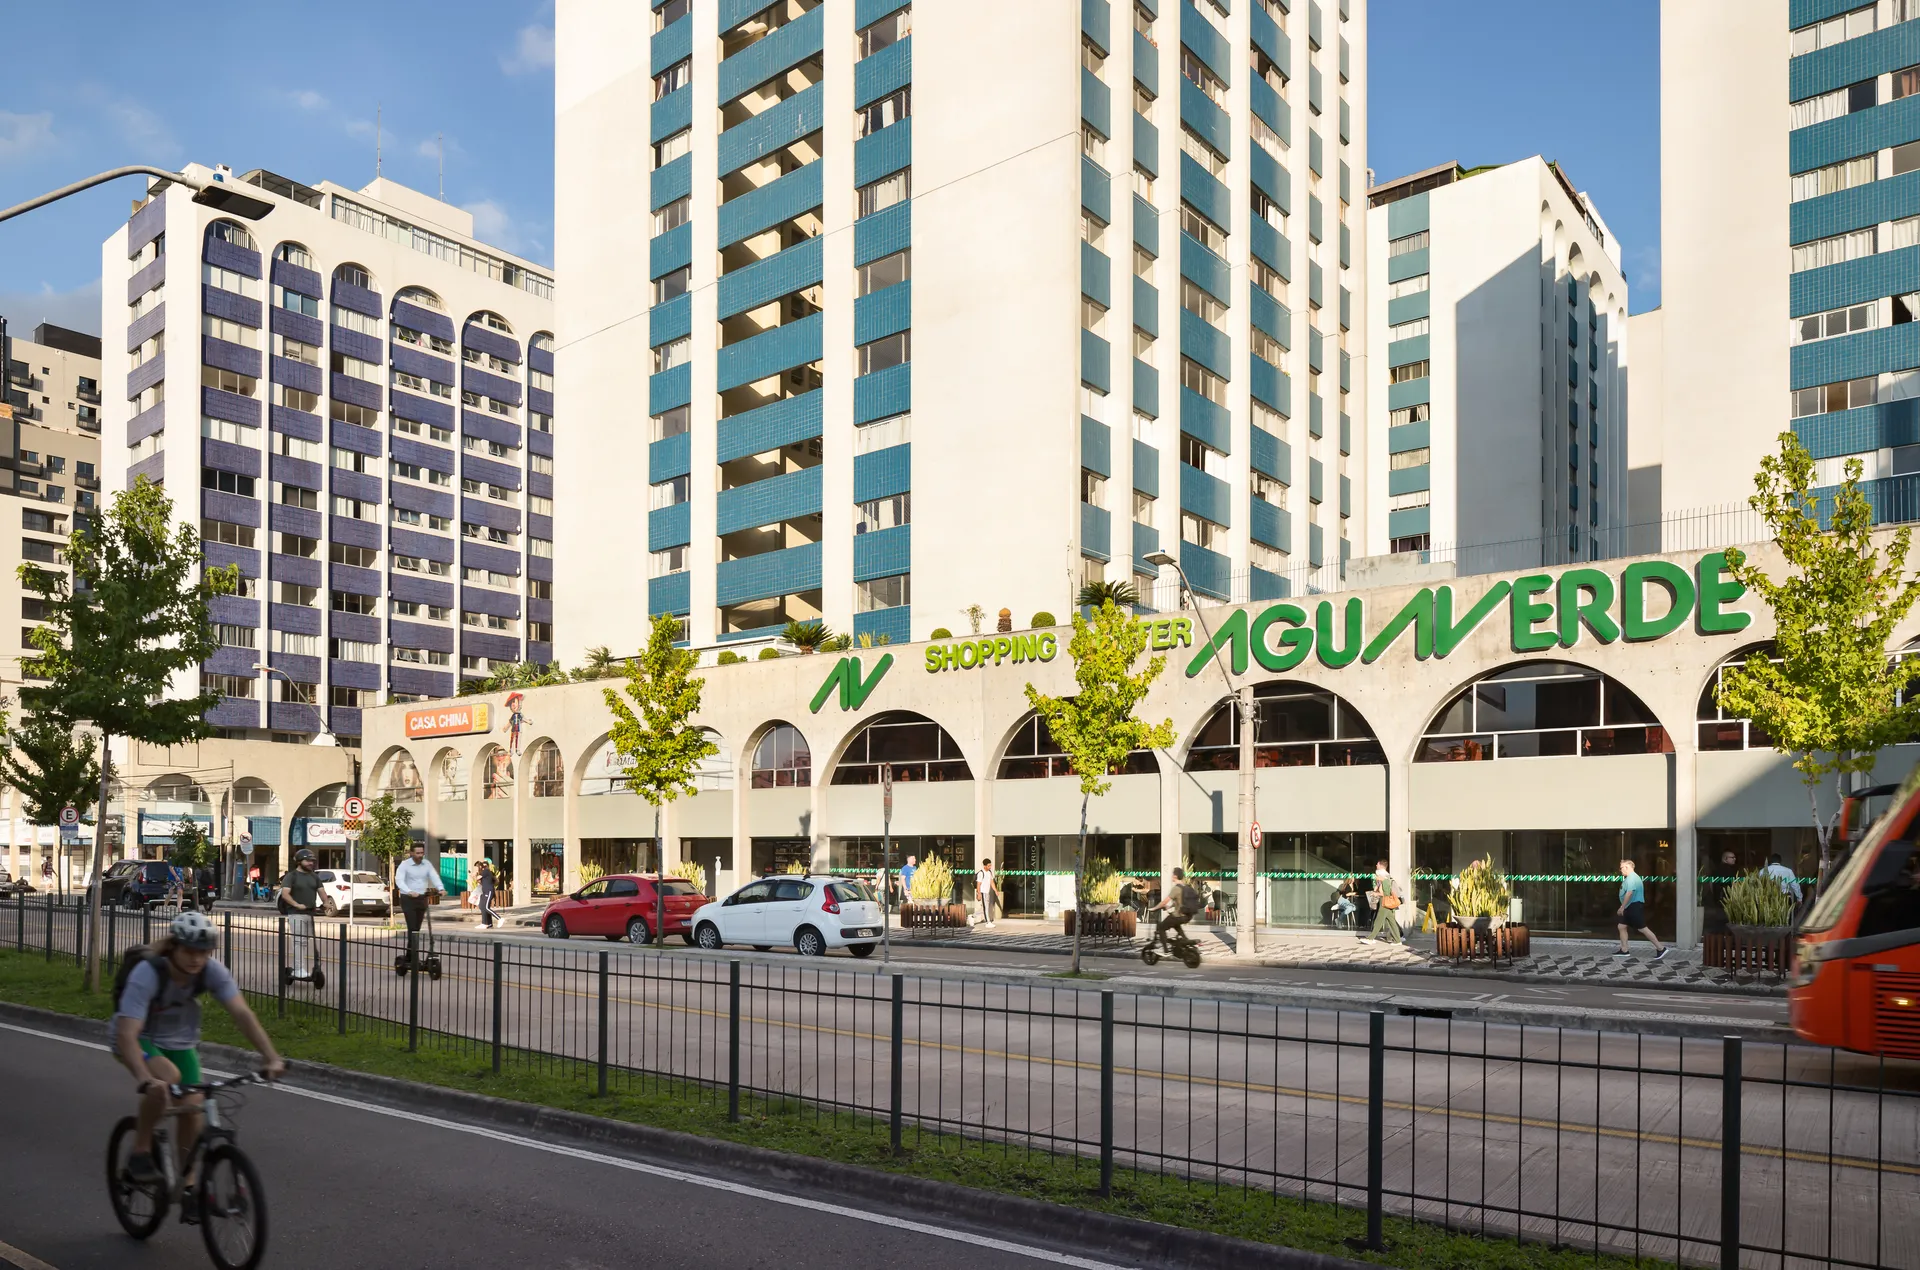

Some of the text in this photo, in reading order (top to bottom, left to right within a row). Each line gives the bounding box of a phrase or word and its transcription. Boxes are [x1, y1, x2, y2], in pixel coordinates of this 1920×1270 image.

[925, 632, 1057, 674] SHOPPING
[410, 715, 437, 731] CASA
[438, 712, 469, 728] CHINA
[66, 810, 73, 820] E
[350, 802, 358, 814] E
